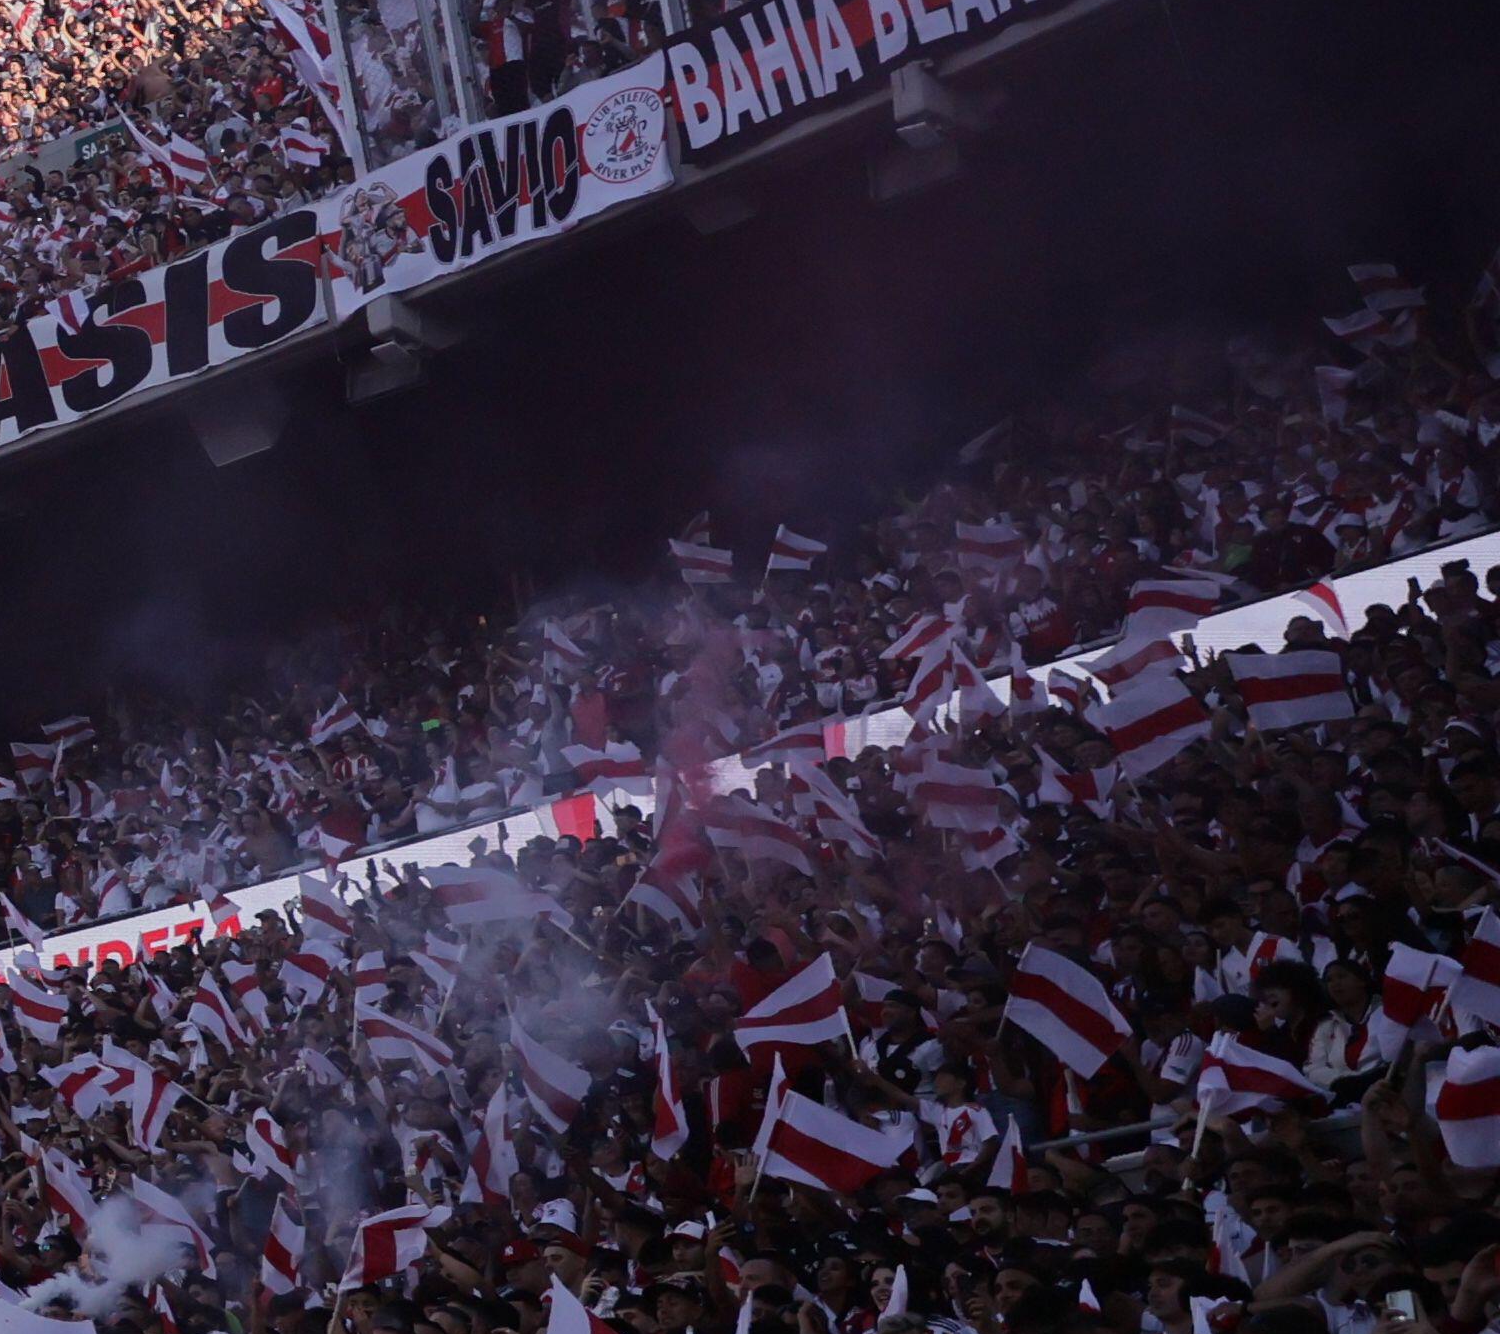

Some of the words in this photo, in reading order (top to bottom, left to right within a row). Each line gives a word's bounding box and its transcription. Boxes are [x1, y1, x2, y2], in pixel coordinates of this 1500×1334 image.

[426, 106, 579, 265] SAVIO
[596, 161, 627, 181] RIVER
[630, 144, 659, 176] PLATE
